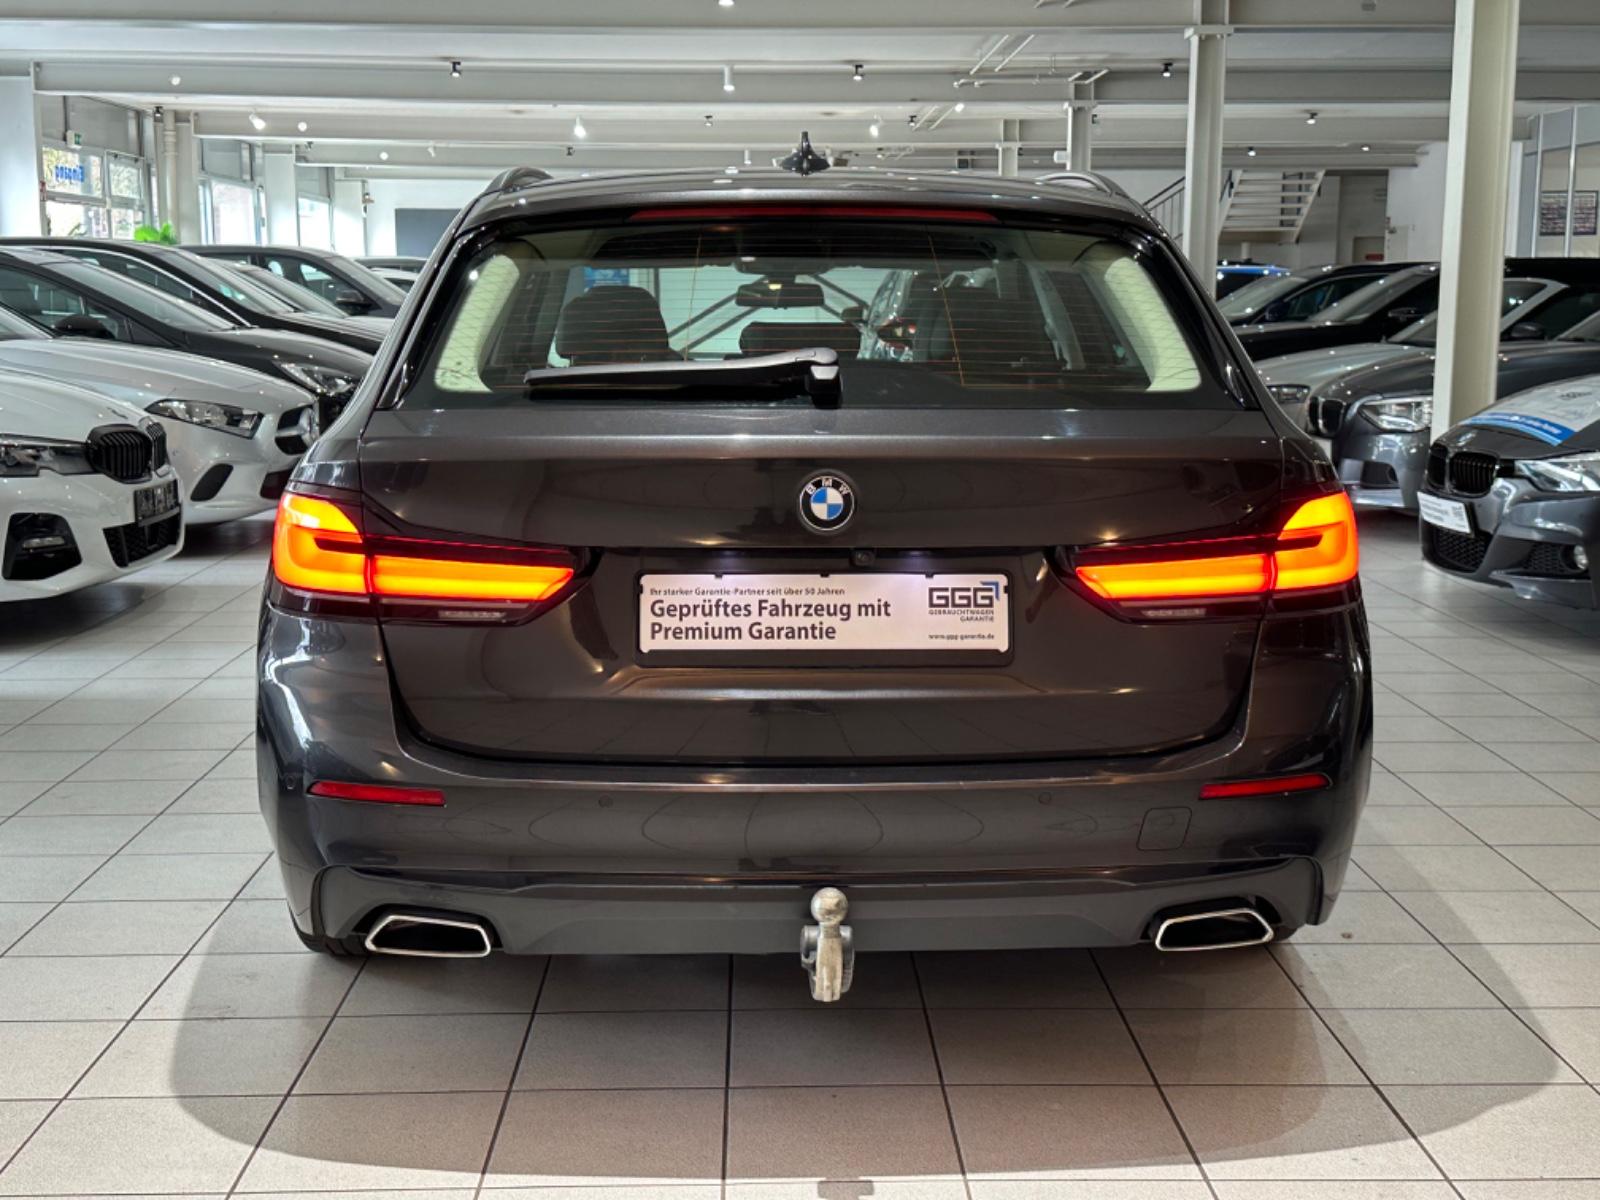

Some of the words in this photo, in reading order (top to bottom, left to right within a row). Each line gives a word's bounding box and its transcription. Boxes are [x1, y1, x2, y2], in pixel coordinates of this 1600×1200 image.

[805, 476, 851, 495] BMW
[650, 588, 662, 596] Ihr
[663, 588, 693, 596] starker
[766, 588, 782, 596] seit
[784, 587, 803, 596] über
[817, 588, 845, 596] Jahren
[928, 587, 994, 608] GGG
[650, 598, 752, 621] Geprüftes
[758, 599, 851, 621] Fahrzeug
[857, 599, 891, 617] mit
[650, 622, 742, 640] Premium
[749, 622, 837, 640] Garantie
